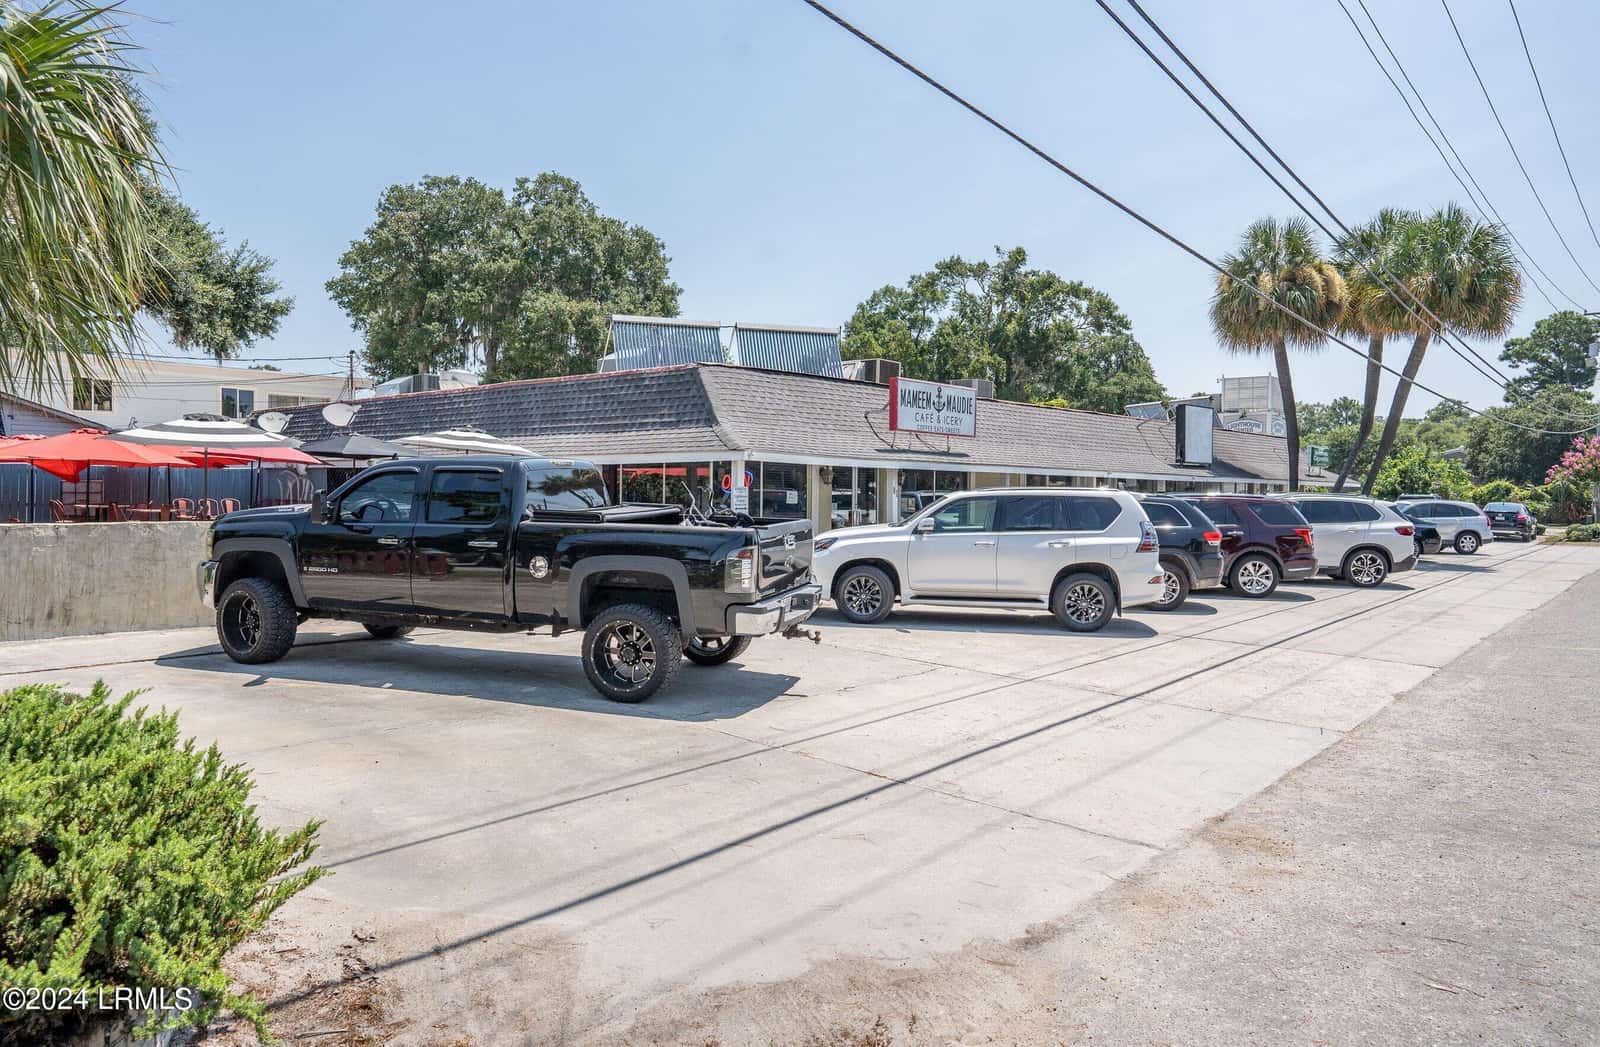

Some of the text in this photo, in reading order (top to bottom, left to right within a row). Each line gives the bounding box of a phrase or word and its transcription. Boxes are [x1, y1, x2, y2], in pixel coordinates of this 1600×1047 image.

[901, 388, 973, 415] MAMEEM MAUDIE
[914, 412, 963, 426] CAFE & ICERY
